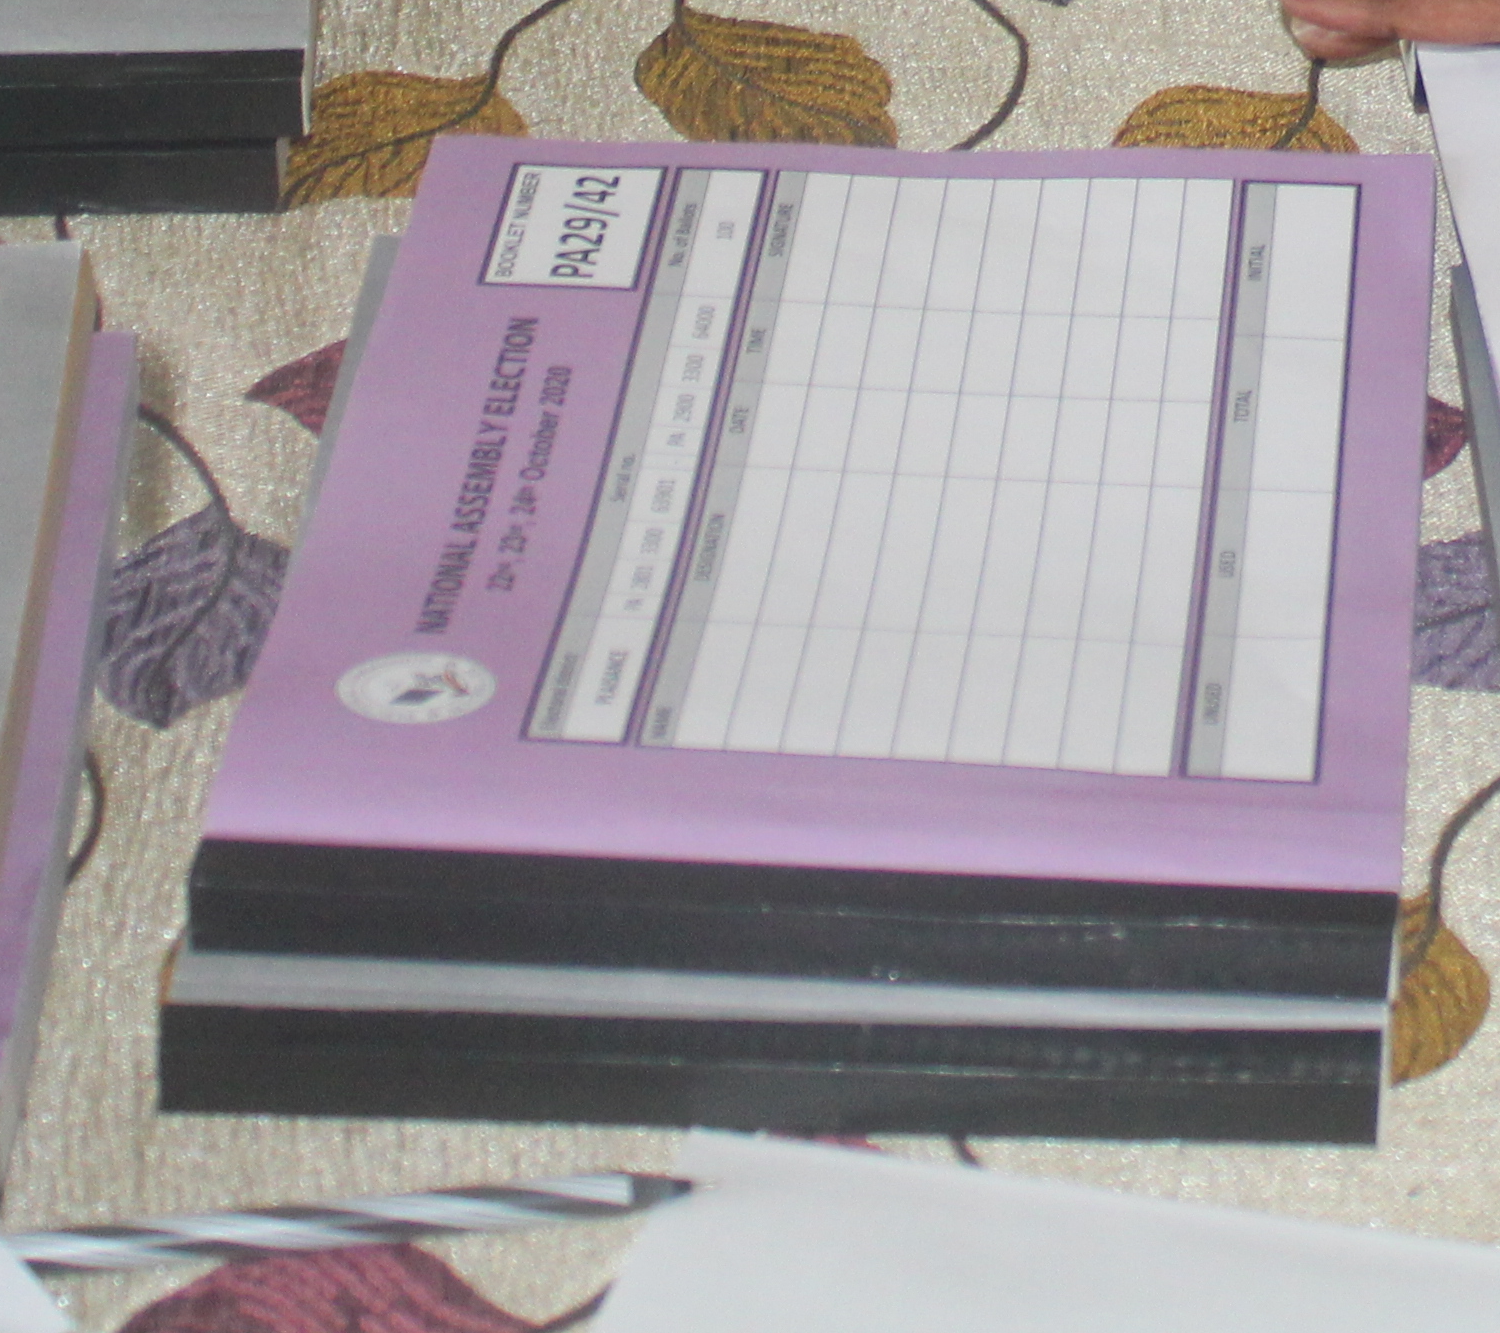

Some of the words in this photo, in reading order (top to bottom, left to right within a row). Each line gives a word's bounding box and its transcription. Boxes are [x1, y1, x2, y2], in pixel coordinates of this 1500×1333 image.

[510, 171, 542, 222] NUMBER
[550, 174, 622, 279] PA29/42
[675, 203, 698, 237] Ballots
[766, 202, 796, 258] SIGNATURE
[494, 223, 528, 279] BOOKLET
[667, 253, 686, 268] No.
[672, 238, 690, 250] of
[1247, 244, 1266, 281] INITIAL
[744, 328, 767, 354] TIME
[537, 365, 573, 406] 2020
[728, 407, 750, 434] DATE
[1233, 389, 1253, 421] TOTAL
[518, 411, 563, 482] October
[415, 539, 478, 633] NATIONAL
[452, 421, 506, 534] ASSEMBLY
[479, 317, 539, 416] ELECTION
[608, 471, 631, 504] Serial
[691, 514, 727, 582] DESIGNATION
[1217, 550, 1237, 578] USED
